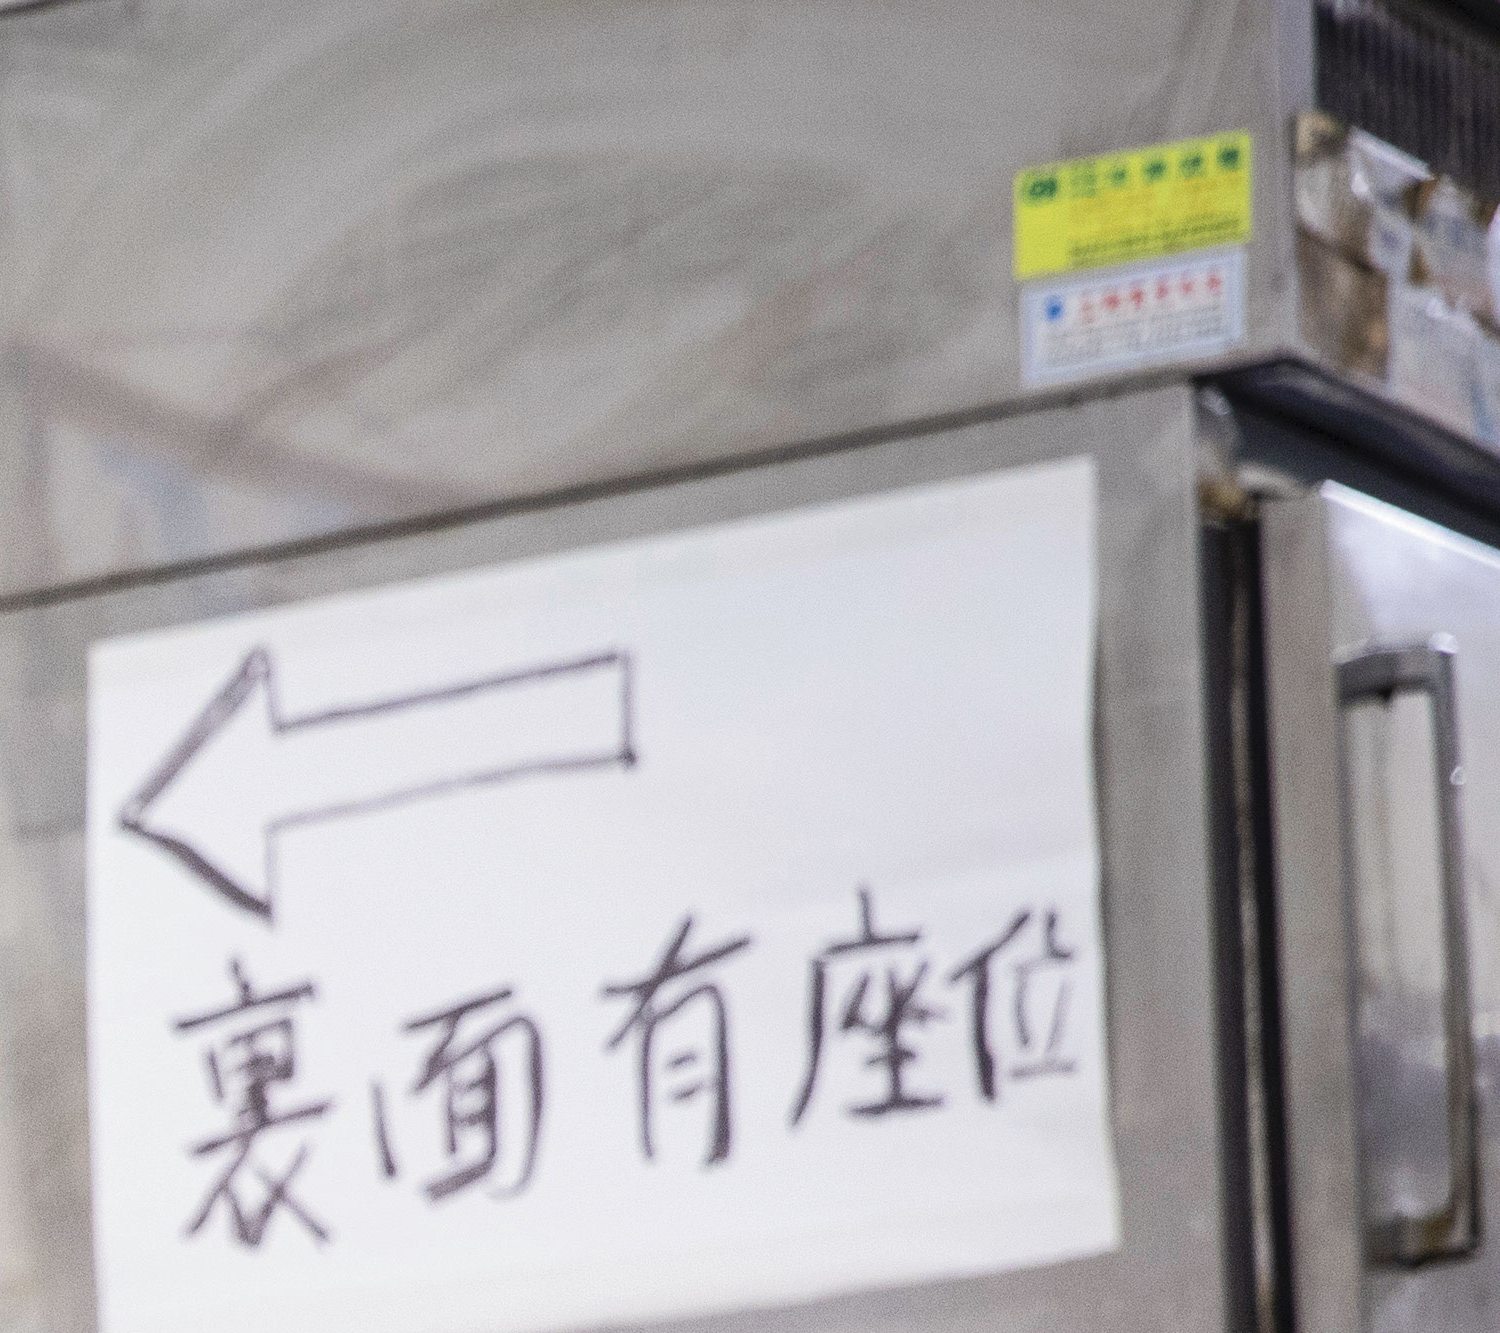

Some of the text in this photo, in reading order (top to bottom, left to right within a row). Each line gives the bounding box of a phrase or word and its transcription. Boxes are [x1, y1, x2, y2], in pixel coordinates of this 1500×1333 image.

[168, 878, 1082, 1251] 裏面有座位
